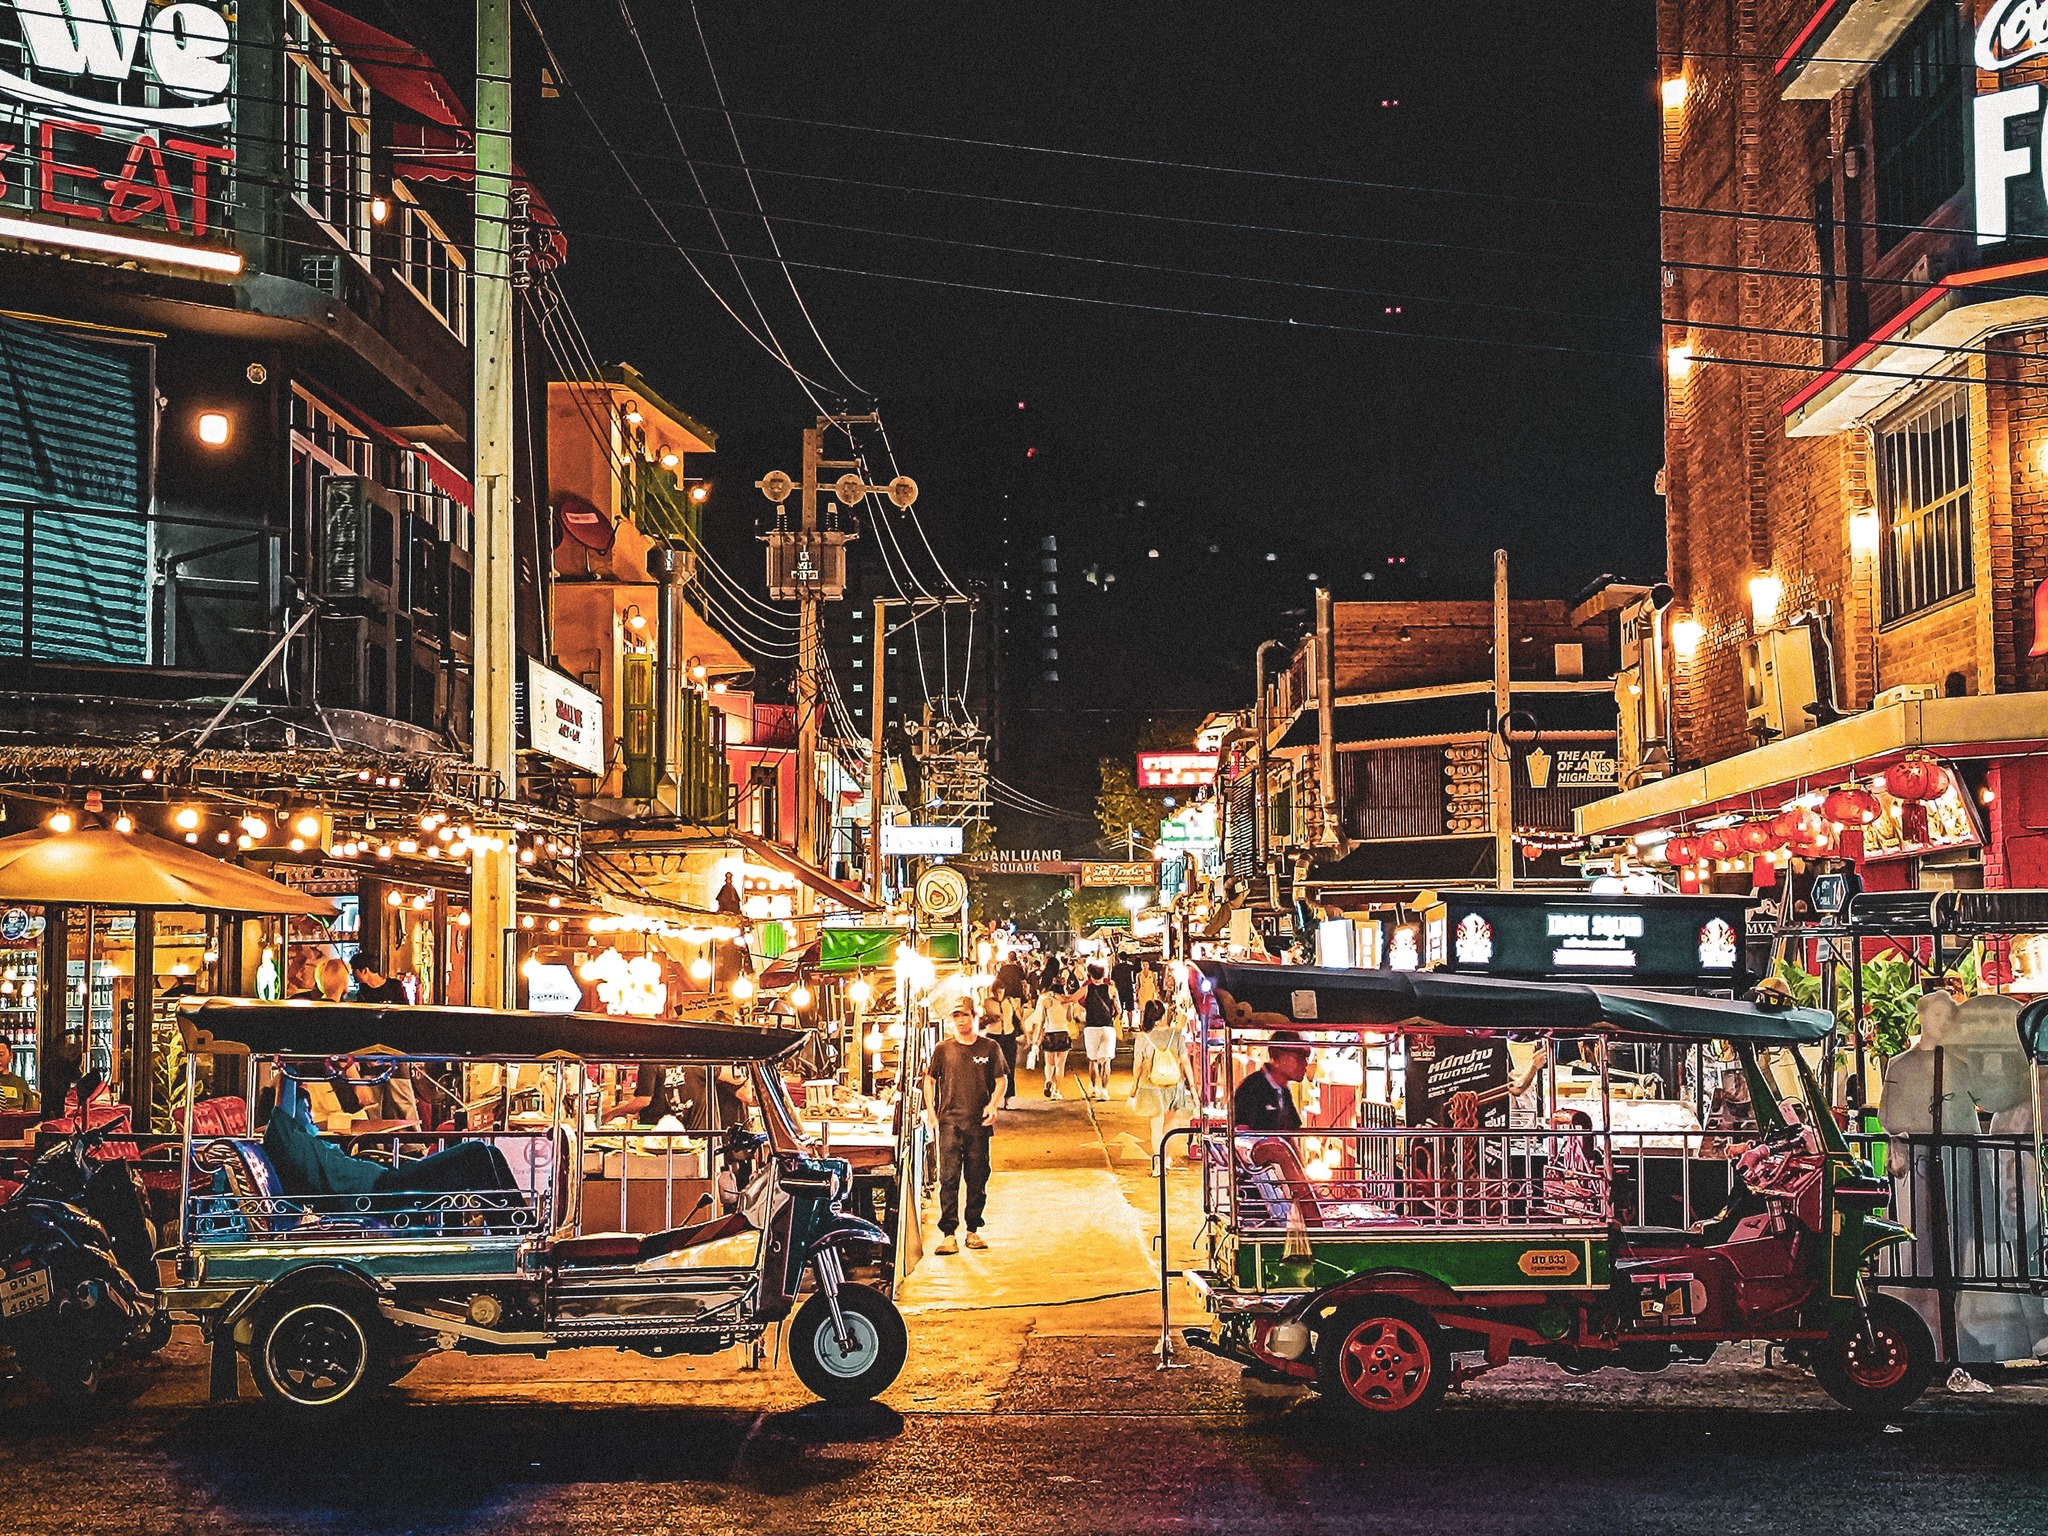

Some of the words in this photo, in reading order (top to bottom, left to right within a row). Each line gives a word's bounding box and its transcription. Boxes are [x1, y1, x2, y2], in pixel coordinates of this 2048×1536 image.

[1973, 84, 2048, 246] F
[40, 119, 236, 236] EAT
[1557, 750, 1580, 761] THE
[1581, 750, 1606, 761] ART
[1557, 761, 1574, 771] OF
[1594, 761, 1611, 773] YES
[991, 862, 1040, 873] SQUARE
